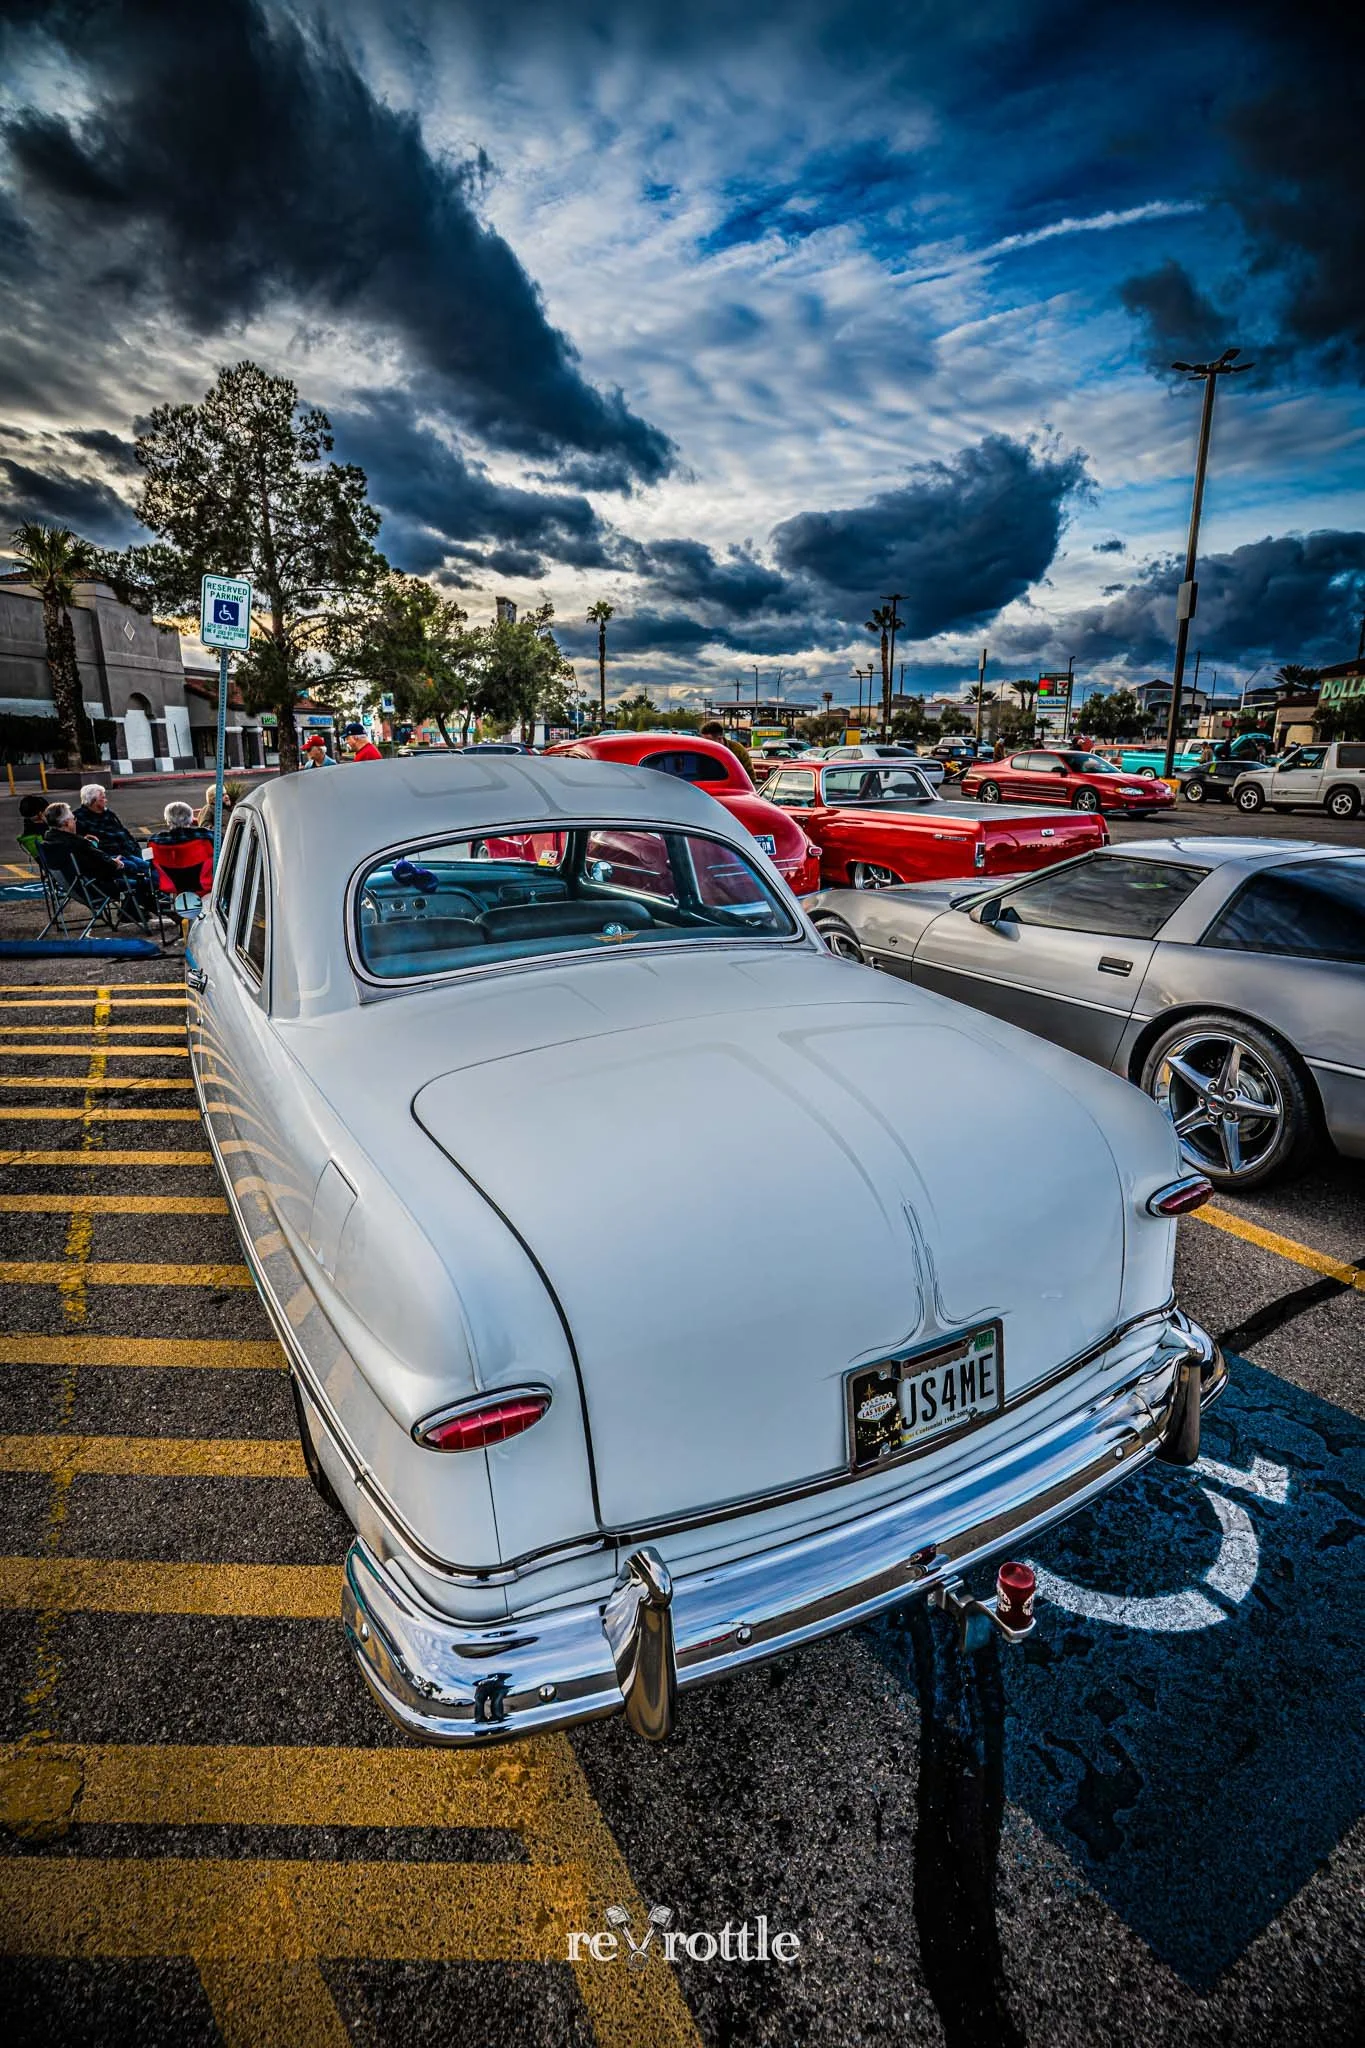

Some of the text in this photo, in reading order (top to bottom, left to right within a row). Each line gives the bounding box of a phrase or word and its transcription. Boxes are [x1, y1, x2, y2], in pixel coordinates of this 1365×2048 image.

[207, 582, 247, 595] RESERVED
[210, 590, 244, 603] PARKING
[901, 1353, 995, 1430] JS4ME
[862, 1408, 874, 1418] LAS
[874, 1401, 894, 1414] VEGAS
